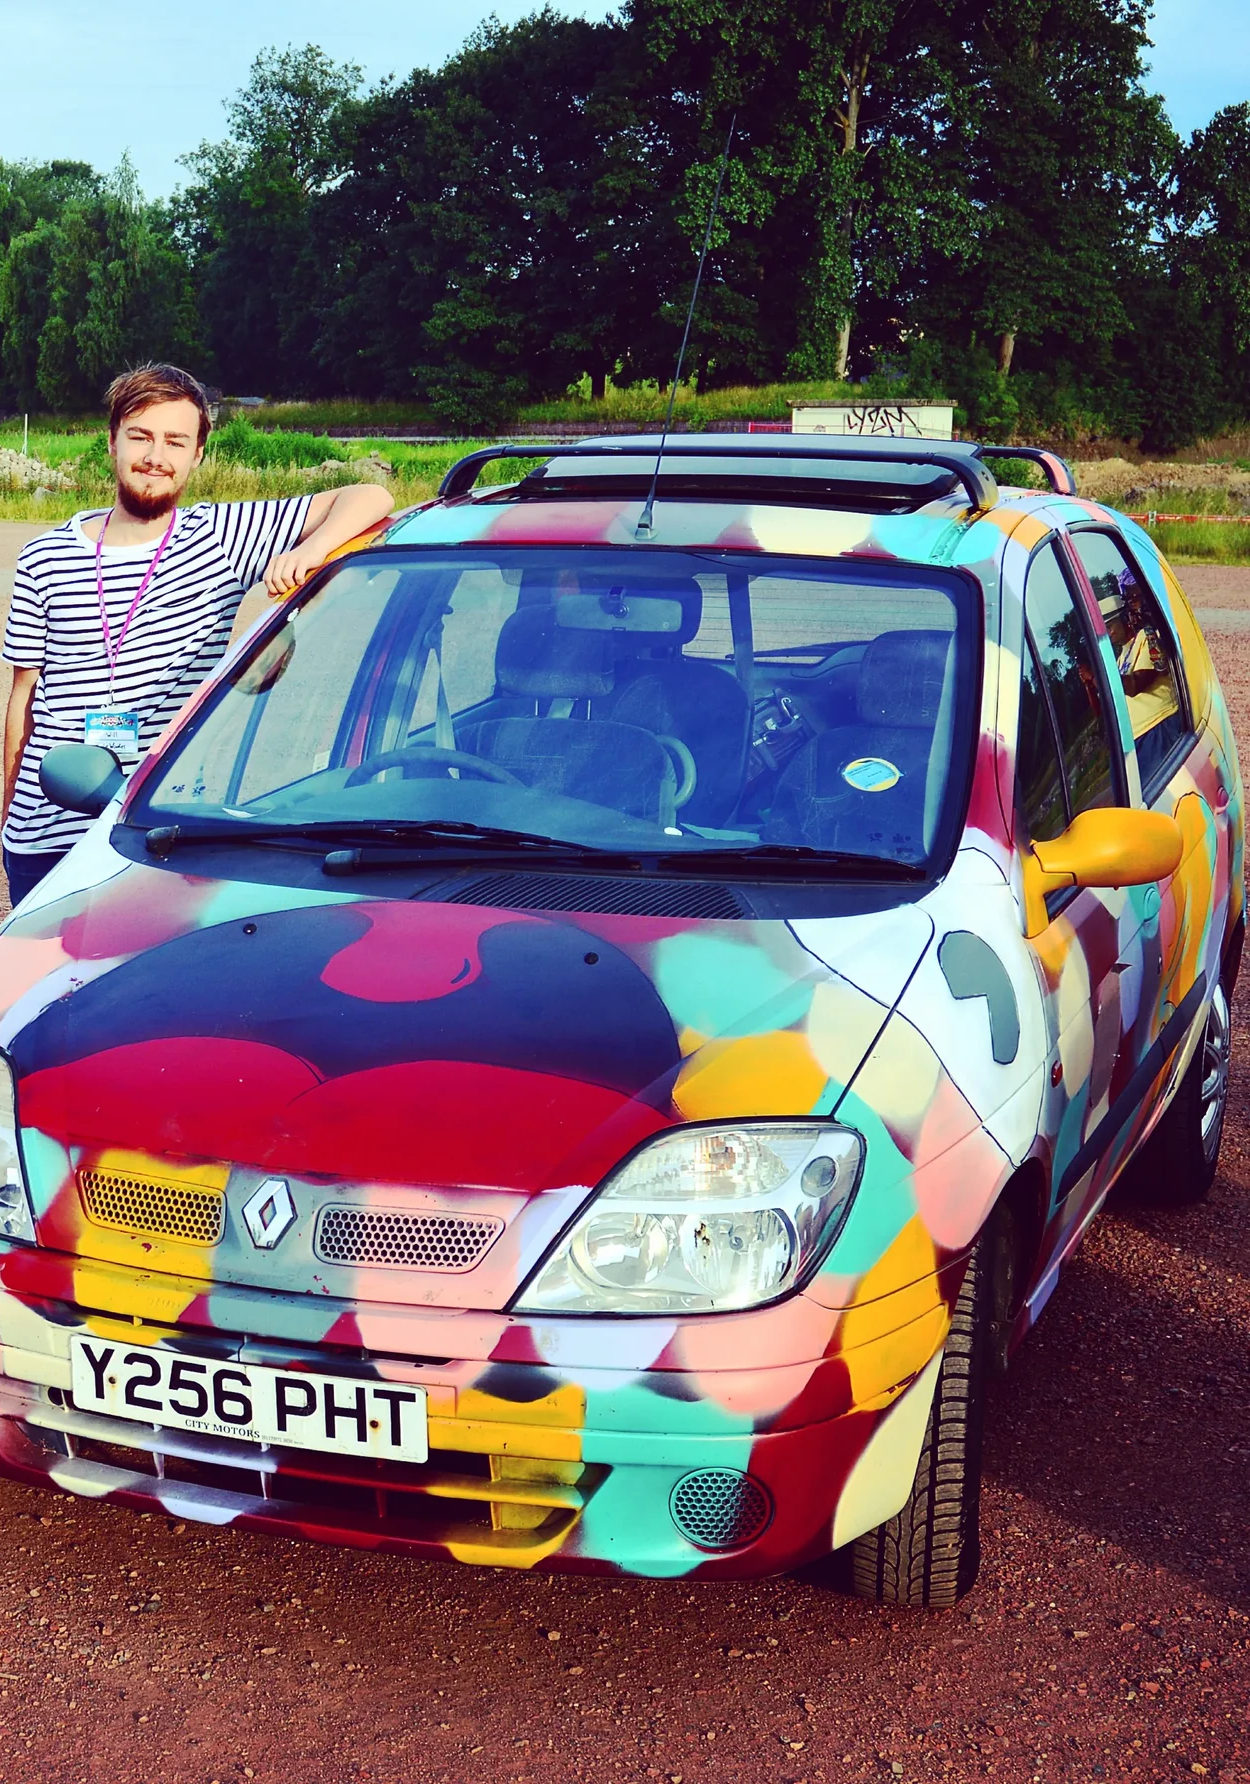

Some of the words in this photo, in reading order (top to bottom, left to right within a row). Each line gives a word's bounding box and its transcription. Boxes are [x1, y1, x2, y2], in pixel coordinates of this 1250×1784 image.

[80, 1343, 253, 1426] Y256
[274, 1376, 417, 1447] PHT
[184, 1418, 210, 1430] CITY
[213, 1422, 261, 1439] MOTORS
